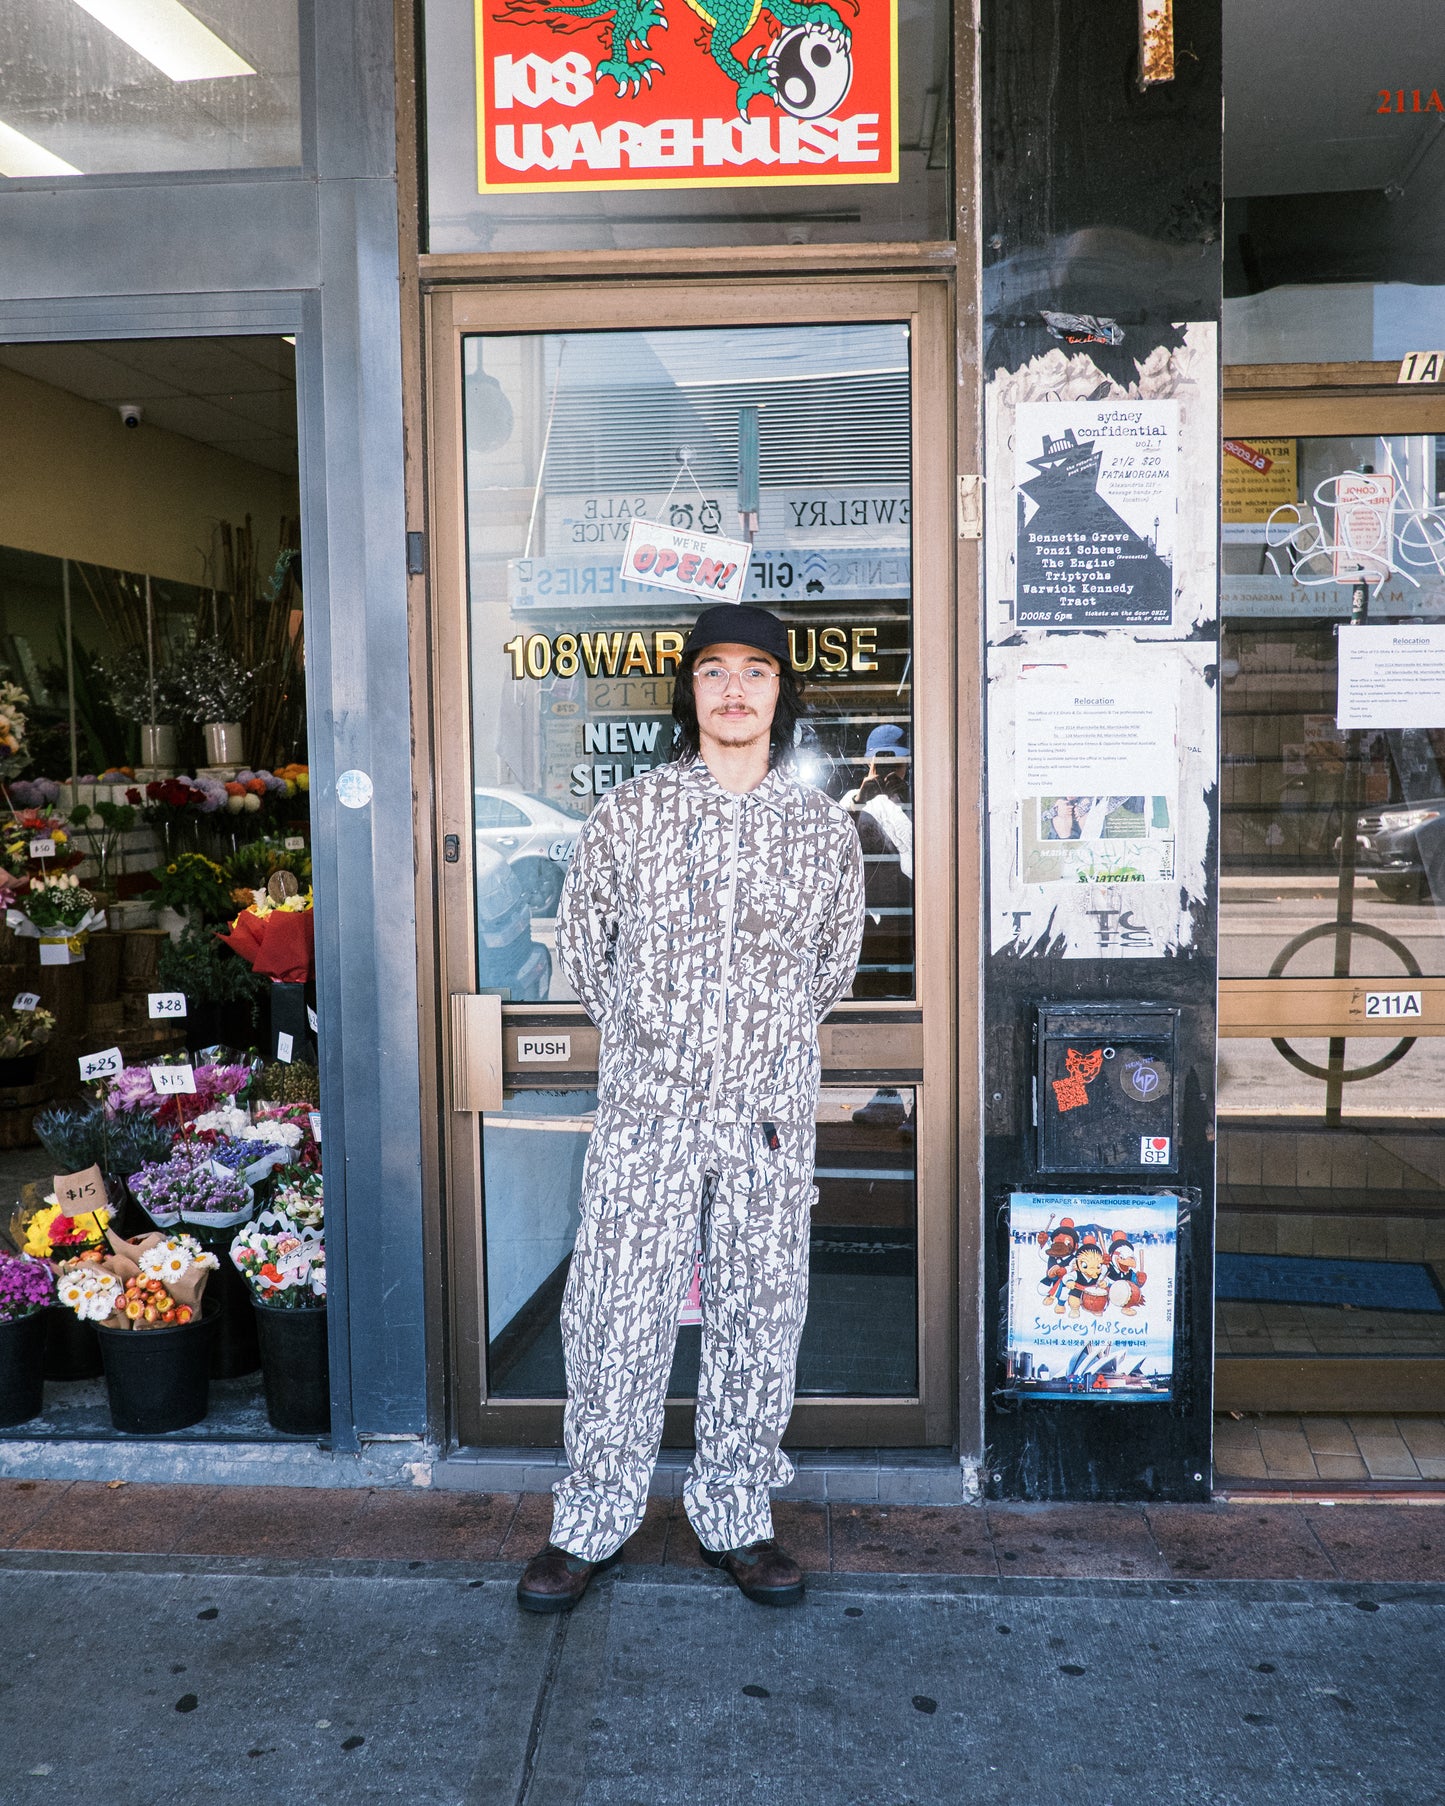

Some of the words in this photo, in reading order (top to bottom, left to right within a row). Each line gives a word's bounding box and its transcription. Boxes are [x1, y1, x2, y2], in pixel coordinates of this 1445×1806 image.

[494, 52, 594, 108] 108
[1376, 89, 1445, 114] 211A
[495, 113, 879, 171] WAREHOUSE
[1097, 411, 1142, 423] sydney
[1078, 425, 1168, 437] confidential
[1112, 457, 1135, 467] 21/2
[1141, 457, 1161, 465] $20
[1101, 470, 1170, 479] FATAMORGANA
[1028, 533, 1086, 543] Bennetts
[1092, 532, 1129, 542] Grove
[673, 536, 707, 552] WE'RE
[1036, 546, 1071, 555] Ponzi
[1077, 545, 1121, 555] Scheme
[633, 544, 737, 591] OPEN!
[1042, 558, 1063, 568] The
[1070, 558, 1115, 569] Engine
[1045, 571, 1111, 582] Triptychs
[1023, 584, 1076, 594] Warwick
[1081, 583, 1134, 595] Kennedy
[1059, 596, 1096, 606] Tract
[1020, 612, 1051, 621] DOORS
[1054, 612, 1073, 622] 6pm
[1392, 637, 1431, 645] Relocation
[503, 626, 879, 680] 108WARUSE
[1074, 697, 1115, 706] Relocation
[583, 722, 660, 755] NEW
[156, 999, 182, 1013] $28
[1367, 995, 1419, 1016] 211A
[524, 1043, 566, 1055] PUSH
[85, 1056, 117, 1075] $25
[160, 1073, 184, 1087] $15
[1145, 1138, 1152, 1149] I
[1144, 1150, 1167, 1163] SP
[66, 1183, 96, 1201] $15
[1034, 1317, 1089, 1336] Sydney
[1091, 1319, 1111, 1334] 108
[1114, 1321, 1148, 1335] Seoul
